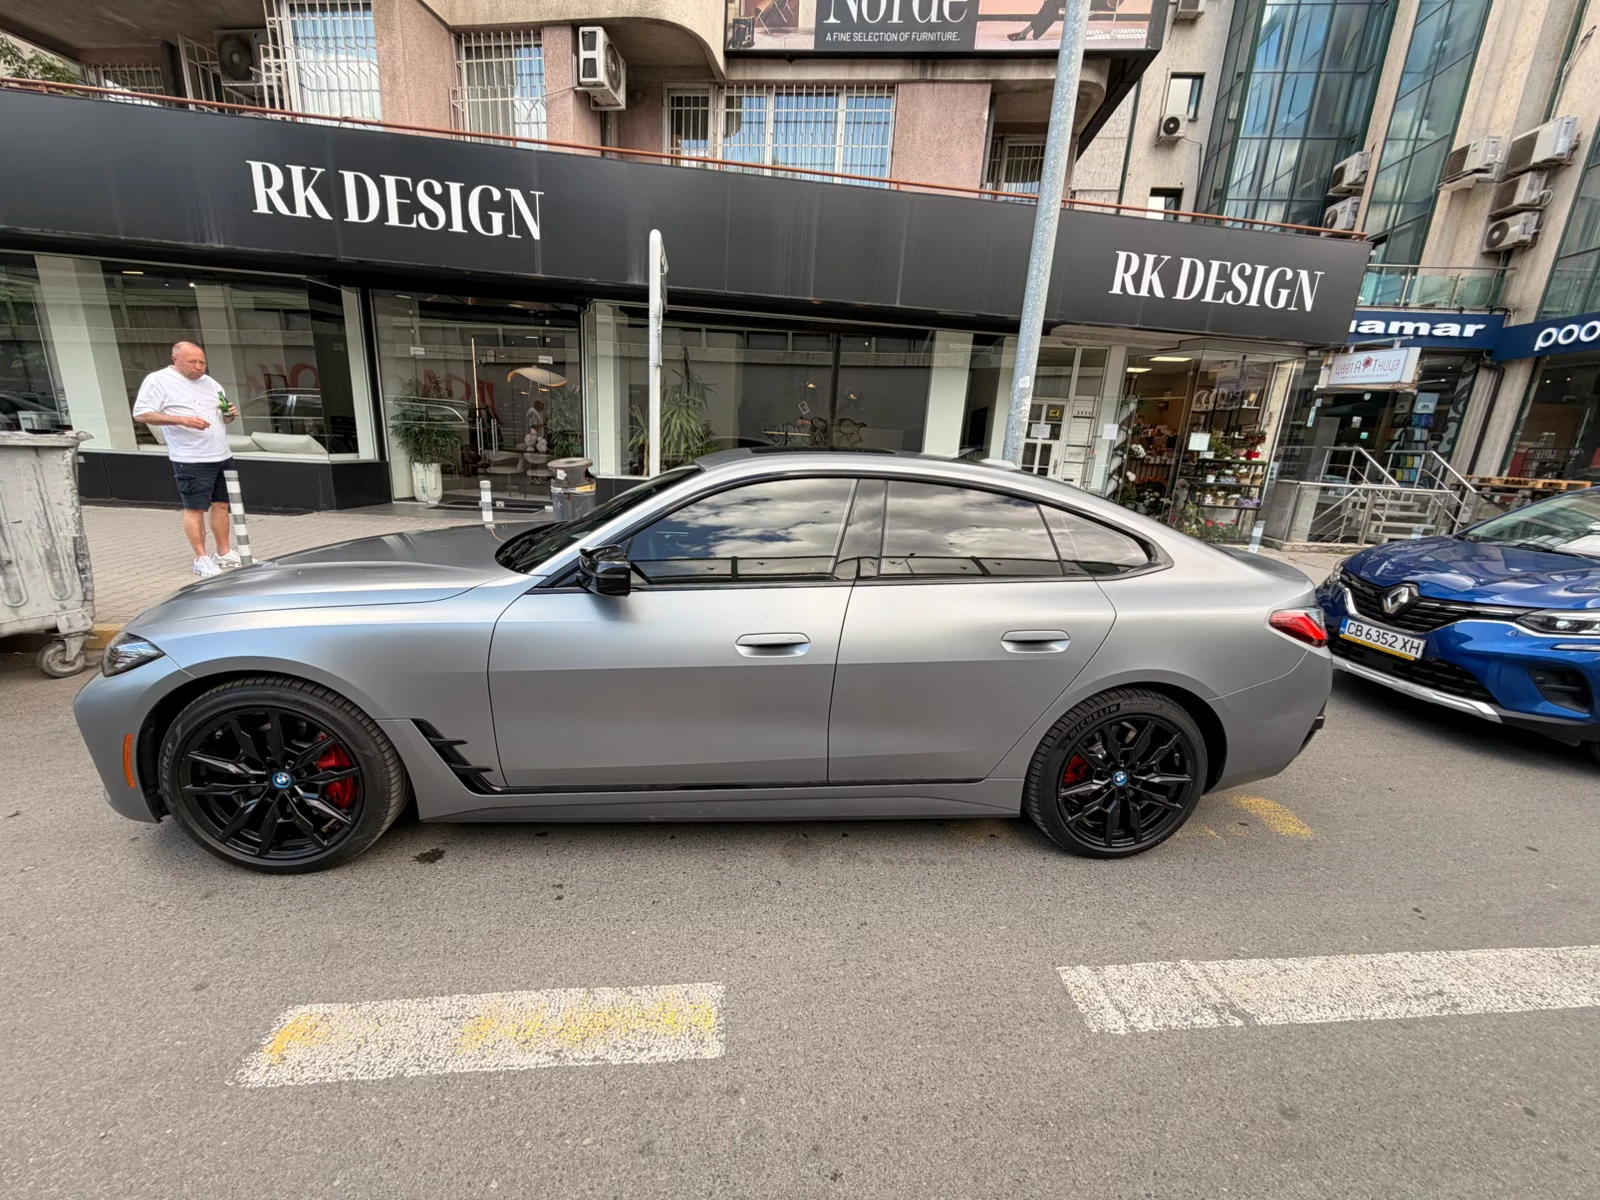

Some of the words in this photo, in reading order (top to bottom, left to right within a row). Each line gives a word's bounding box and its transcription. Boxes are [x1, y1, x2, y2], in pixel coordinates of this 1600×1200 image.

[825, 32, 832, 42] A
[833, 32, 851, 42] FINE
[853, 32, 898, 42] SELECTION
[899, 32, 910, 42] OF
[911, 31, 960, 42] FURNITURE.
[245, 160, 333, 220] RK
[338, 170, 544, 240] DESIGN
[1108, 250, 1172, 298] RK
[1172, 257, 1325, 312] DESIGN
[1365, 627, 1398, 649] 6352
[1068, 703, 1118, 739] MICHELIN
